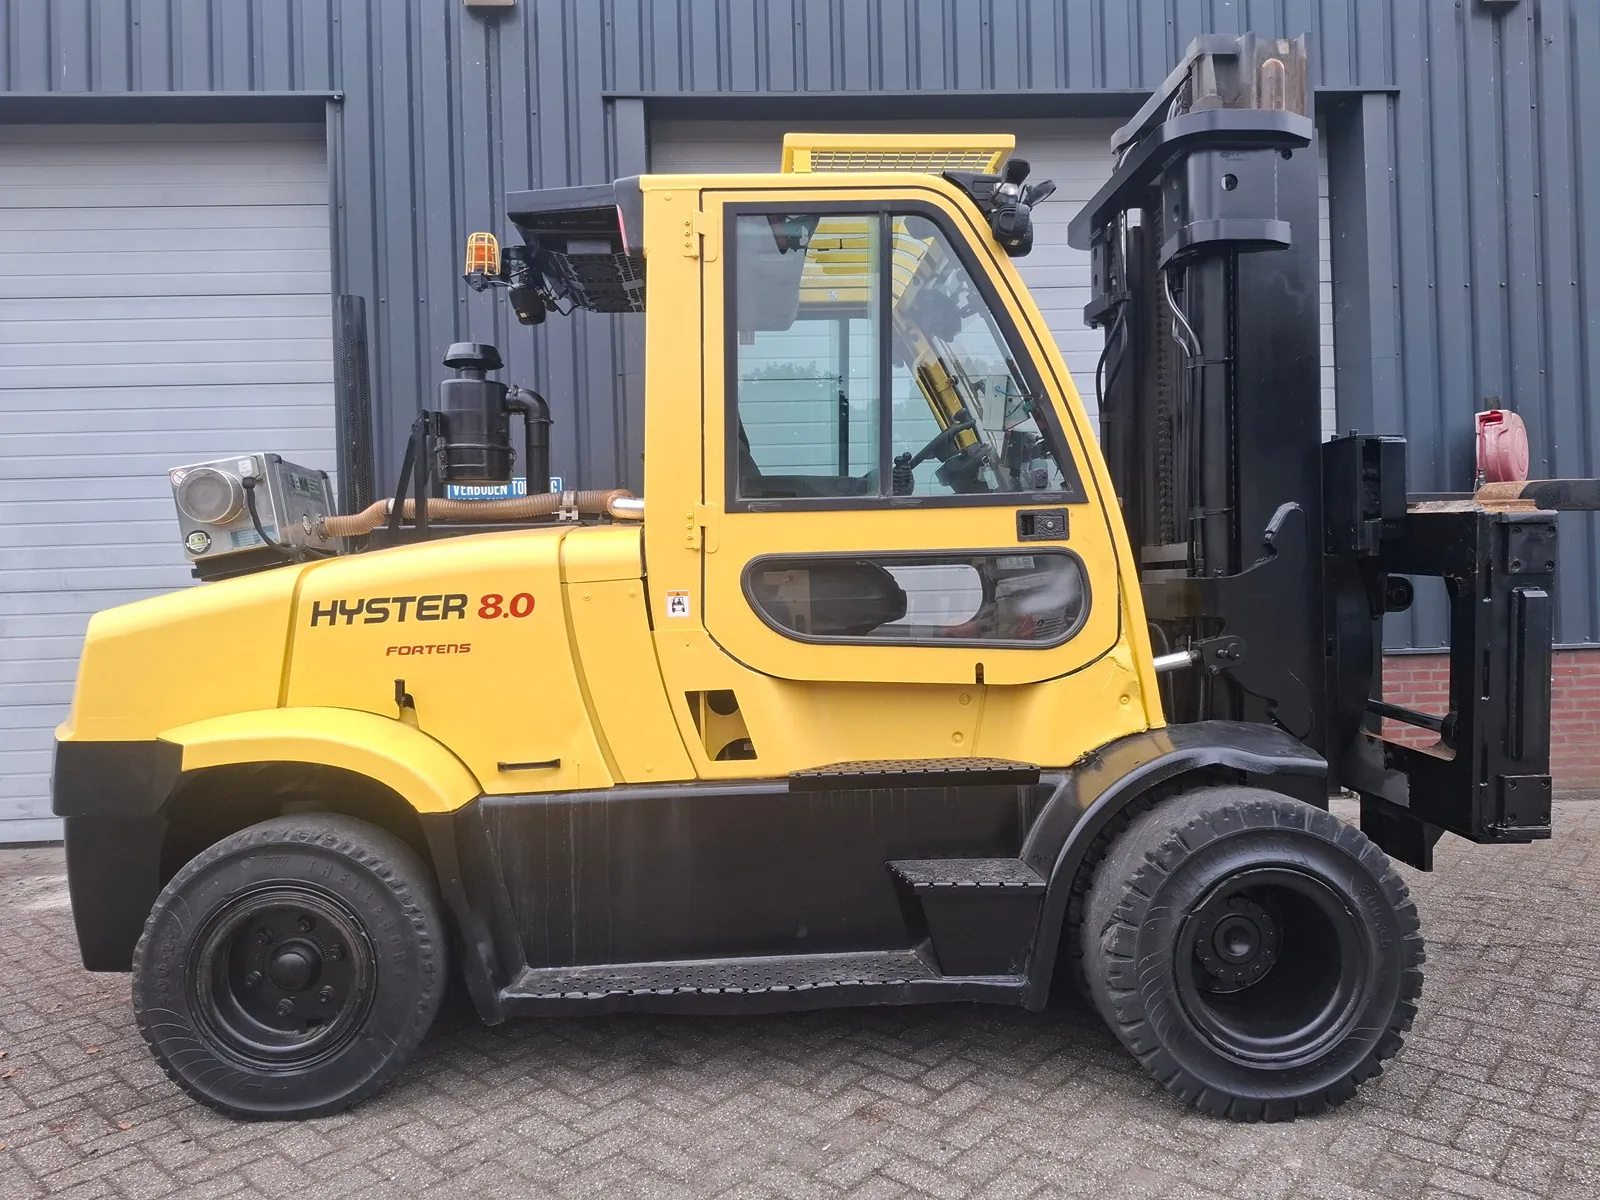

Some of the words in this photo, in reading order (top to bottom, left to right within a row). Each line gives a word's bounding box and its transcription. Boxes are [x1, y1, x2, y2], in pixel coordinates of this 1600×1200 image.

[310, 594, 468, 627] HYSTER
[477, 592, 535, 619] 8.0
[386, 643, 471, 656] FORTENS
